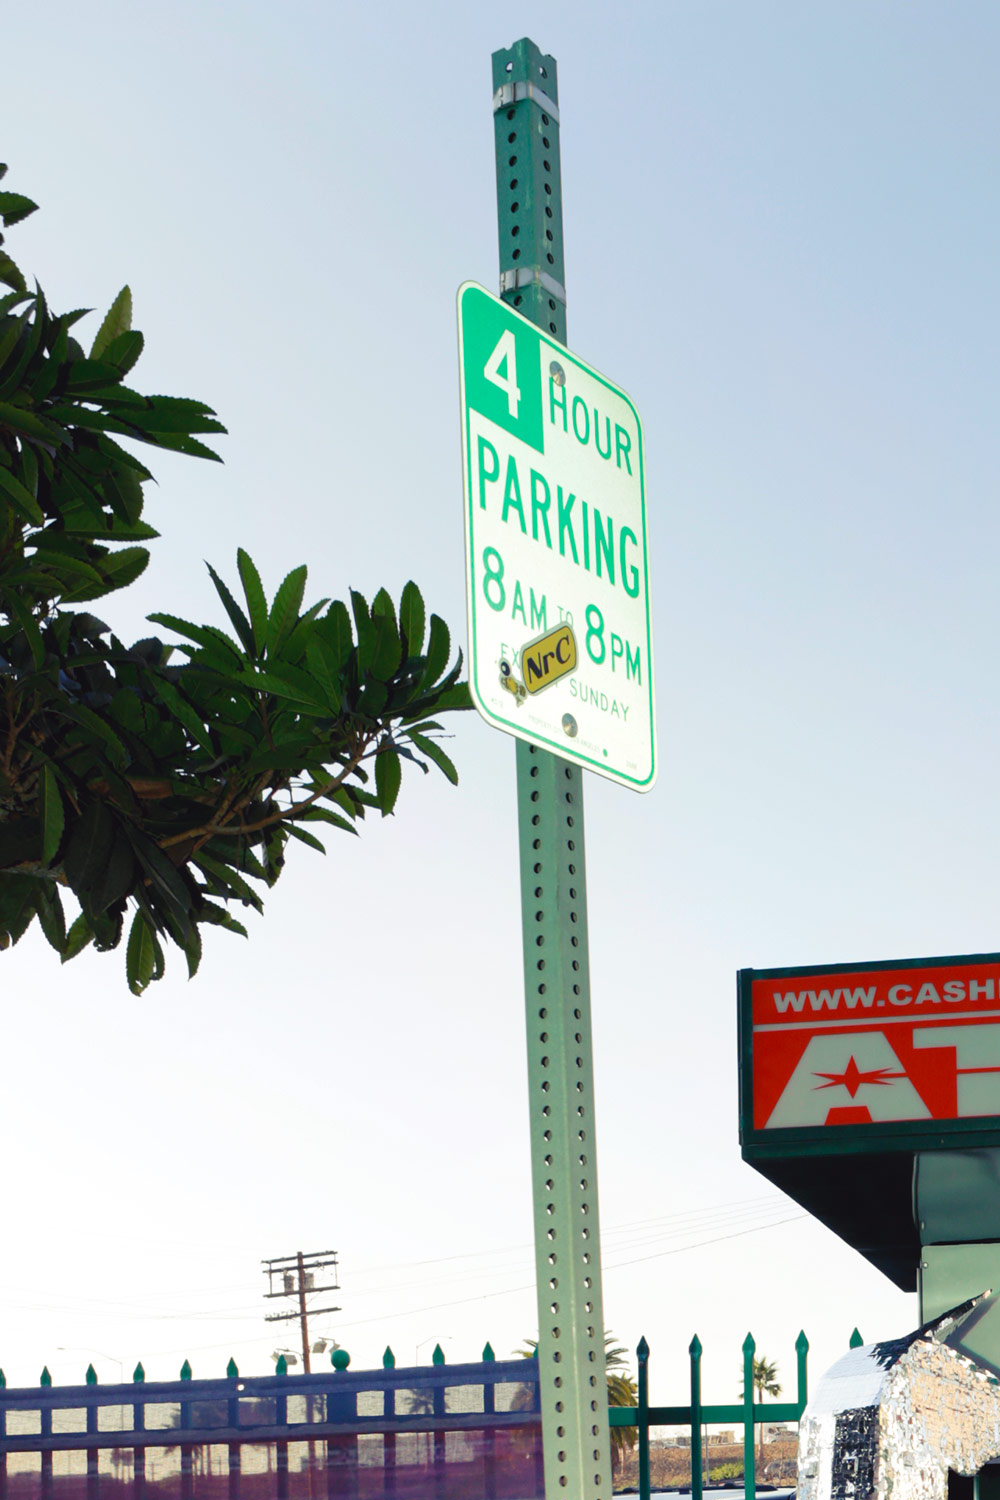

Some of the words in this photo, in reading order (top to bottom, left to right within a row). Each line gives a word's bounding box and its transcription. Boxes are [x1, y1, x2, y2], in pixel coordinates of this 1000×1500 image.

[483, 329, 522, 420] 4
[549, 376, 633, 477] HOUR
[477, 433, 641, 599] PARKING
[526, 634, 572, 684] NrC
[585, 604, 642, 686] 8PM
[569, 678, 629, 721] SUNDAY
